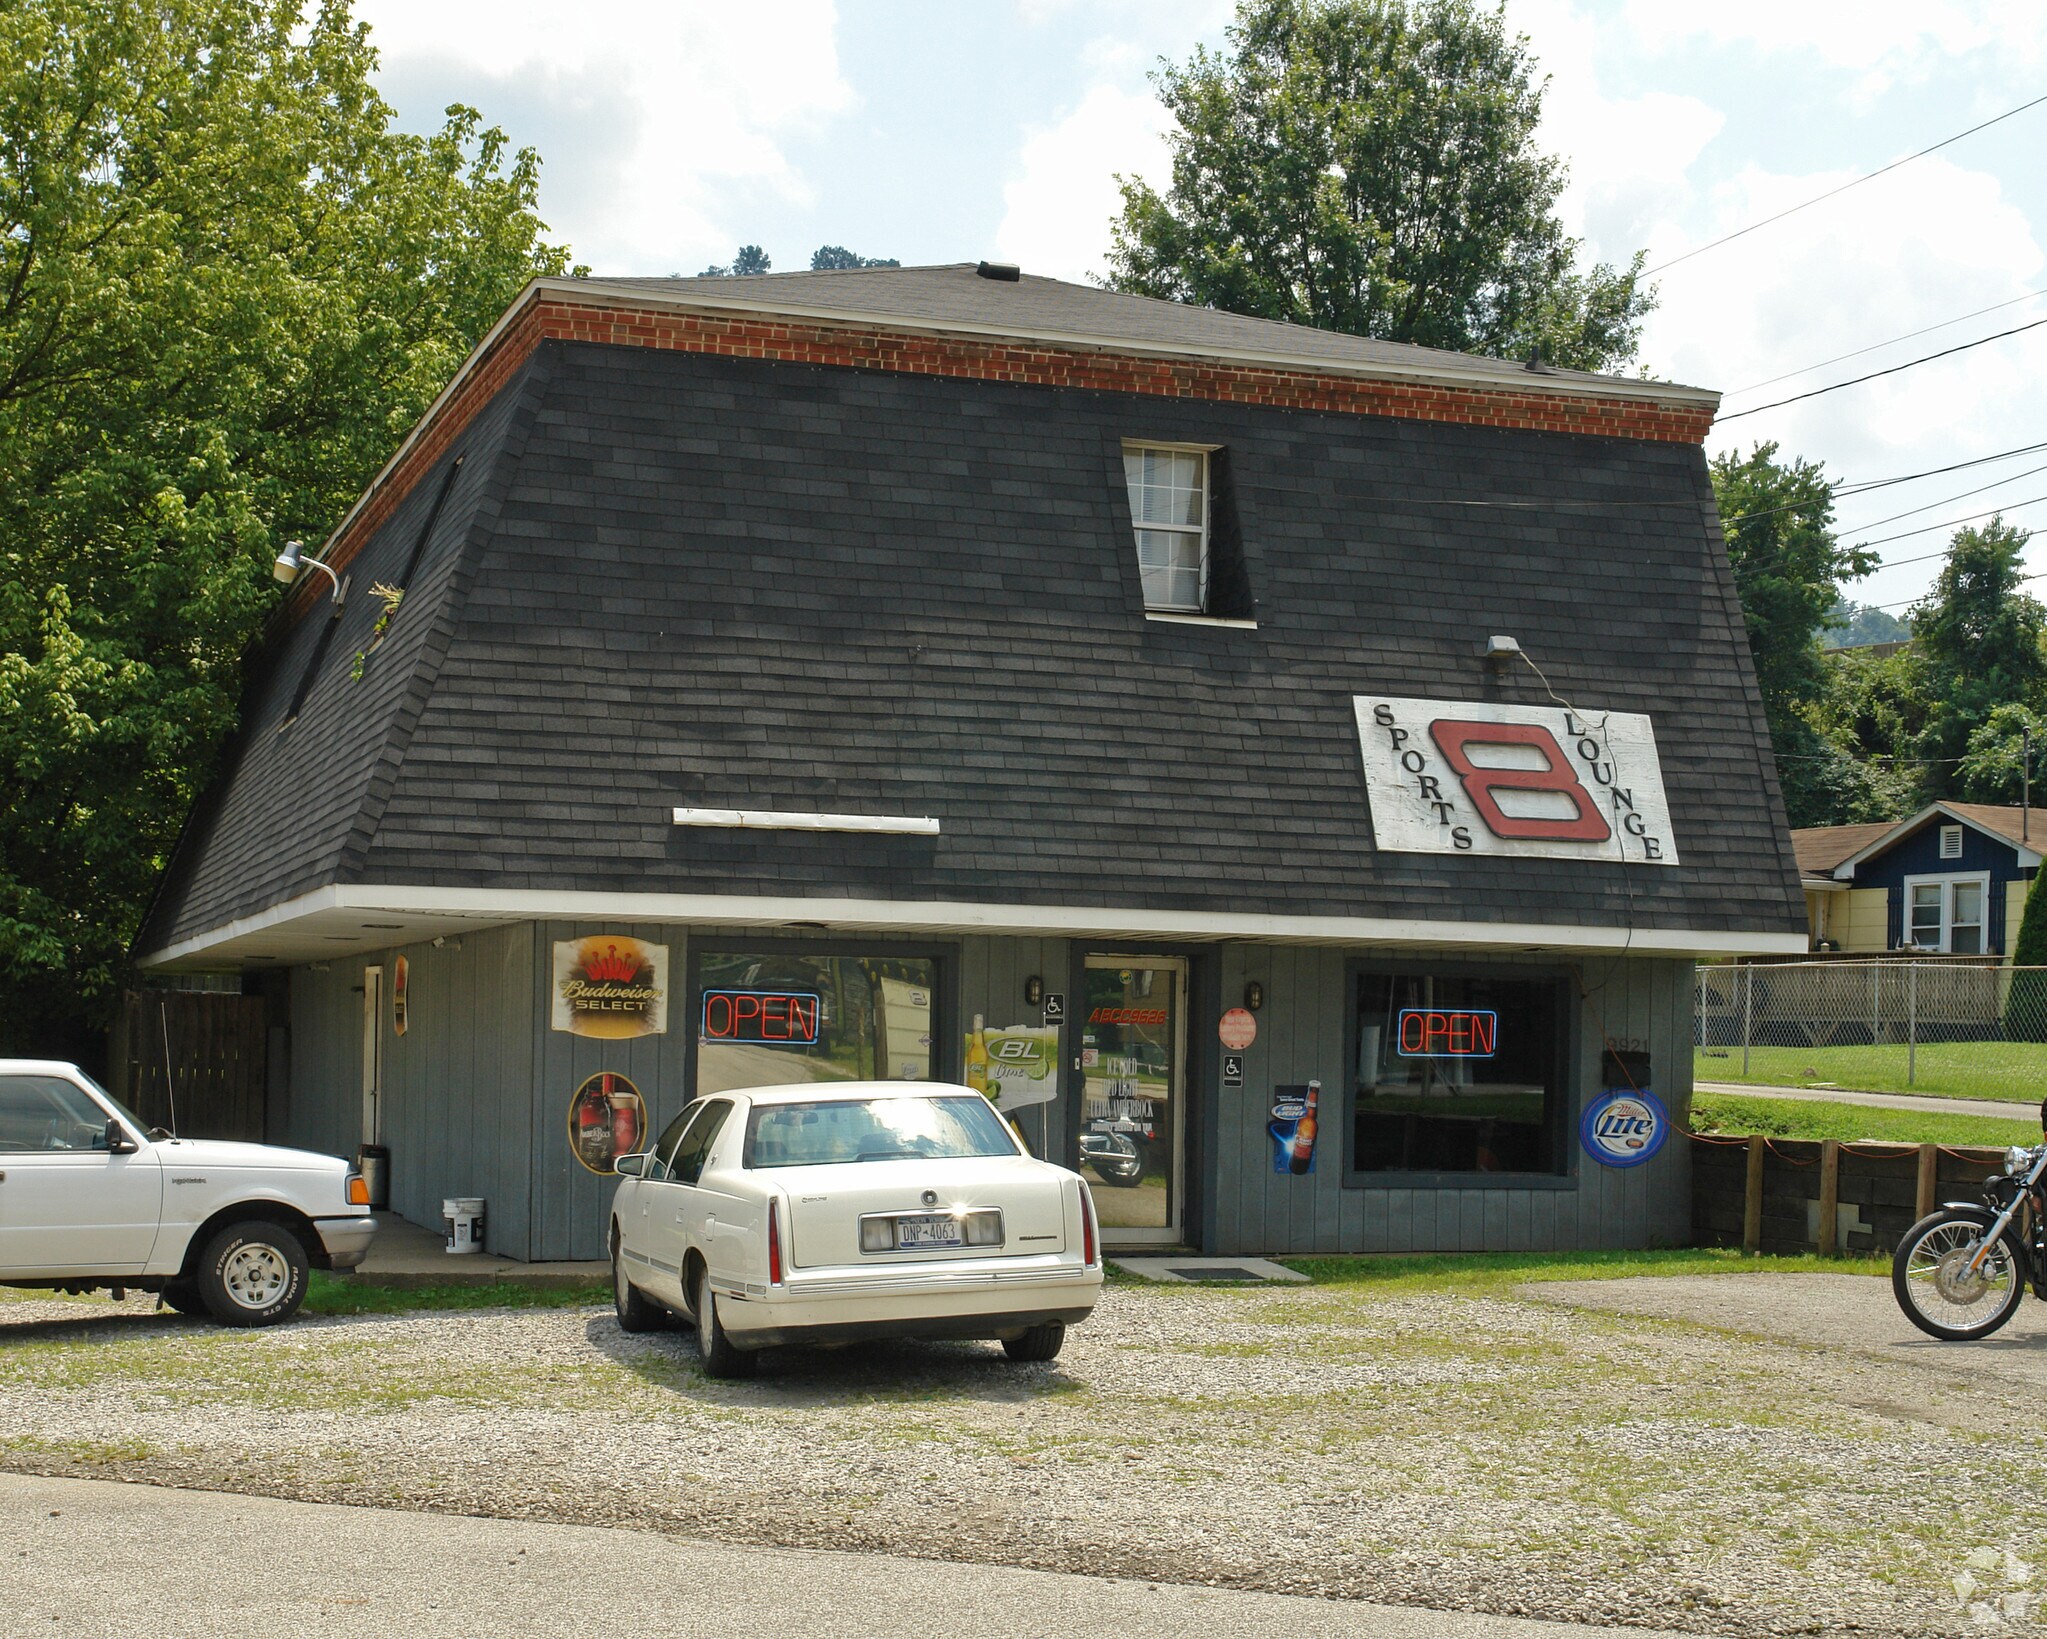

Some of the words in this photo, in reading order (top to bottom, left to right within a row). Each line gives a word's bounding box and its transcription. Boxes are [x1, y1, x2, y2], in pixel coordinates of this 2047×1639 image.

[1373, 703, 1473, 850] SPORTS
[1428, 718, 1612, 843] 8
[1563, 712, 1663, 860] LOUNGE
[560, 979, 663, 999] Budweiser
[575, 999, 647, 1011] SELECT
[706, 994, 816, 1040] OPEN
[1401, 1012, 1494, 1054] OPEN
[998, 1040, 1041, 1059] BL
[1598, 1115, 1653, 1139] Lite
[903, 1225, 922, 1242] DNP
[930, 1223, 955, 1240] 4063
